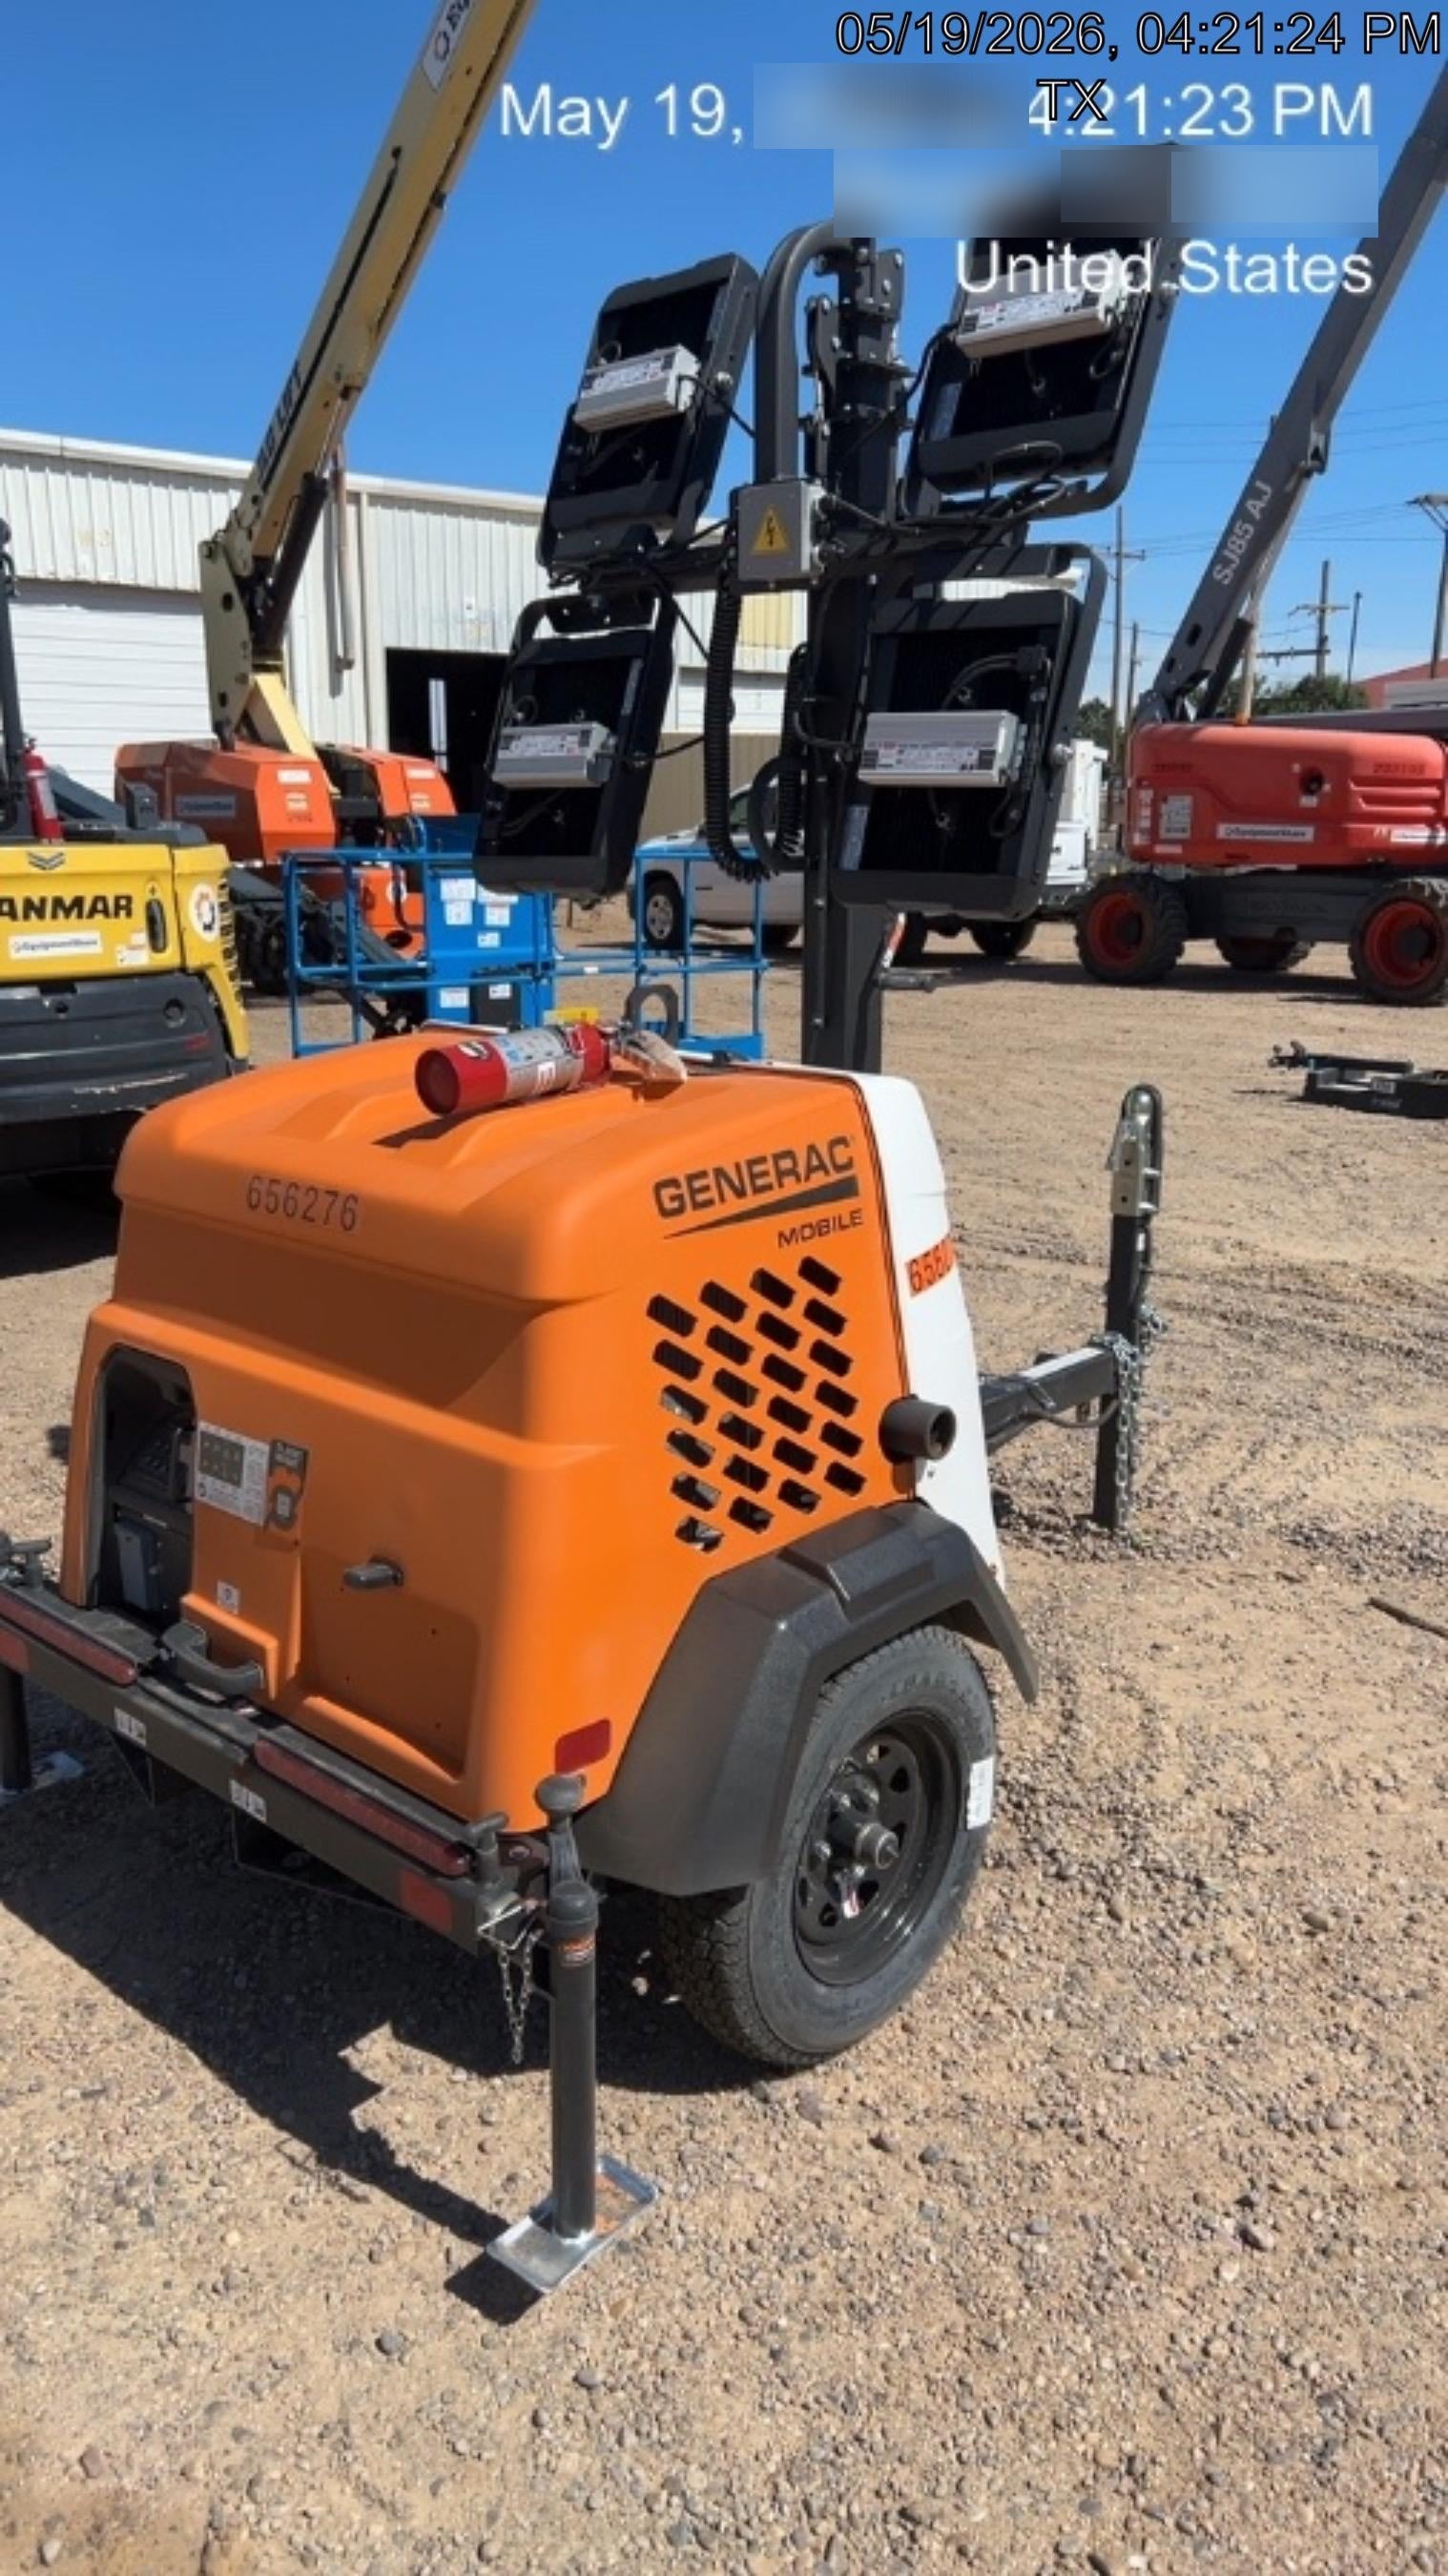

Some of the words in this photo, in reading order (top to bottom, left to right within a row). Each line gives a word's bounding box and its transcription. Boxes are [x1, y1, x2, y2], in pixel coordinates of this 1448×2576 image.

[1212, 519, 1254, 585] SJ85
[1244, 479, 1272, 520] AJ
[246, 1174, 360, 1232] 656276
[652, 1135, 856, 1219] GENERAC
[777, 1208, 864, 1249] MOBILE
